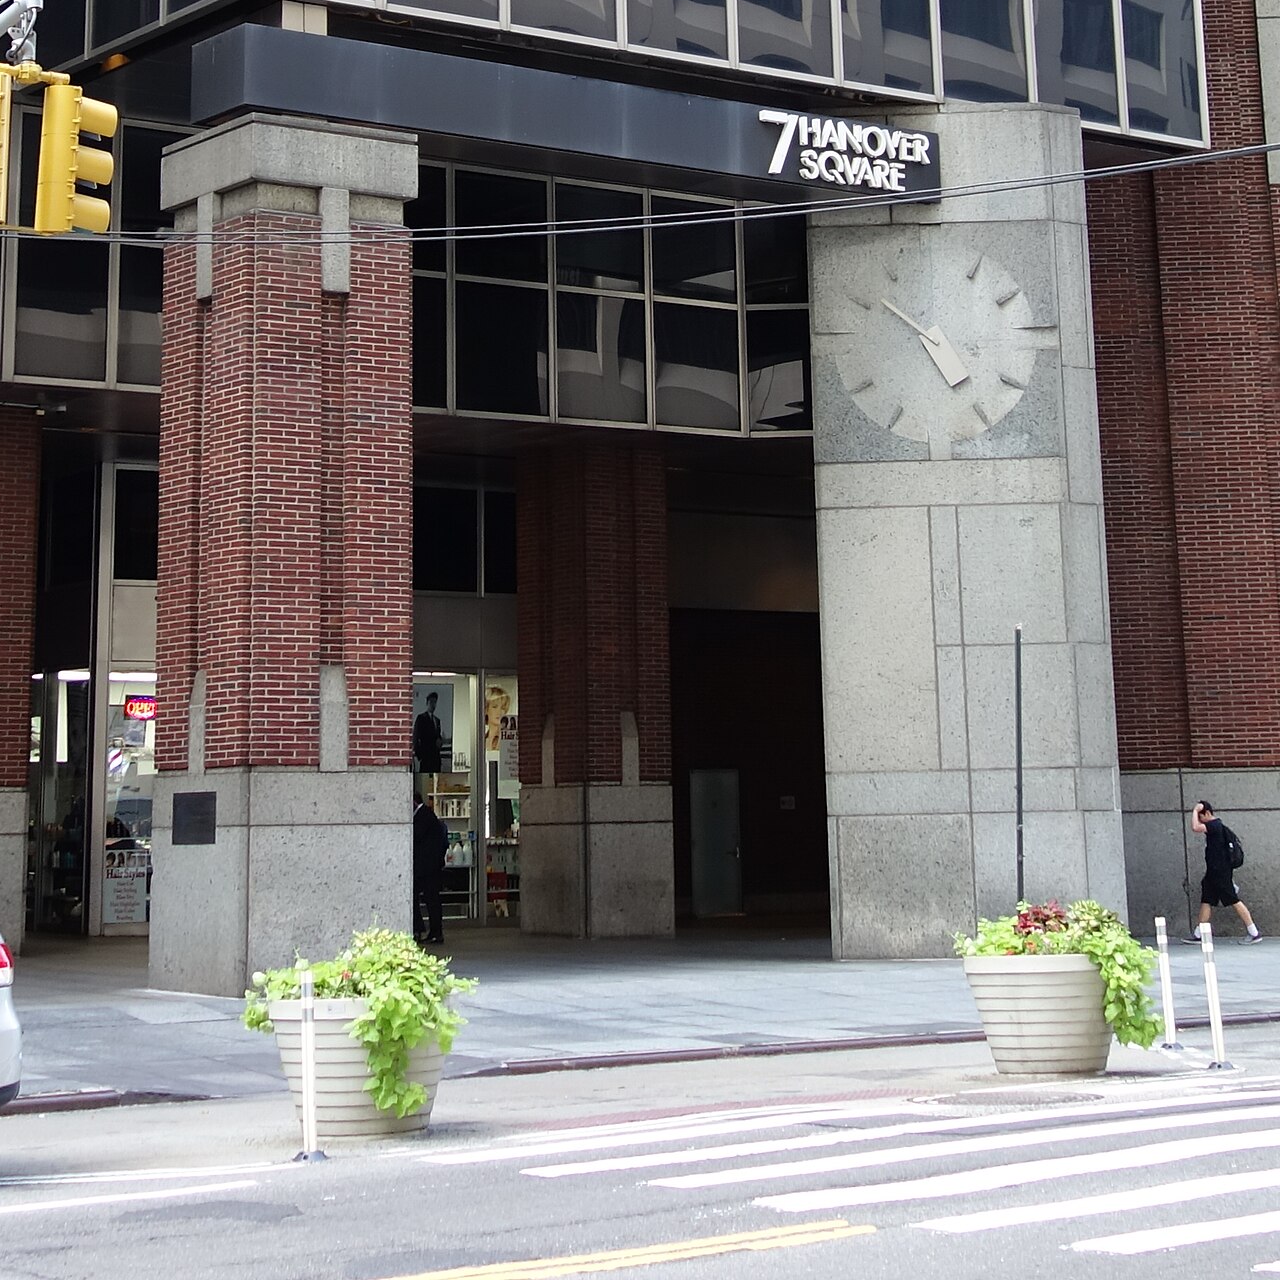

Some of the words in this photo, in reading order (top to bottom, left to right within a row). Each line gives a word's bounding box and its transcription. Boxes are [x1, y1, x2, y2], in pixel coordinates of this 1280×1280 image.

[759, 110, 799, 174] 7
[798, 116, 931, 165] HANOVER
[106, 868, 123, 879] Hair
